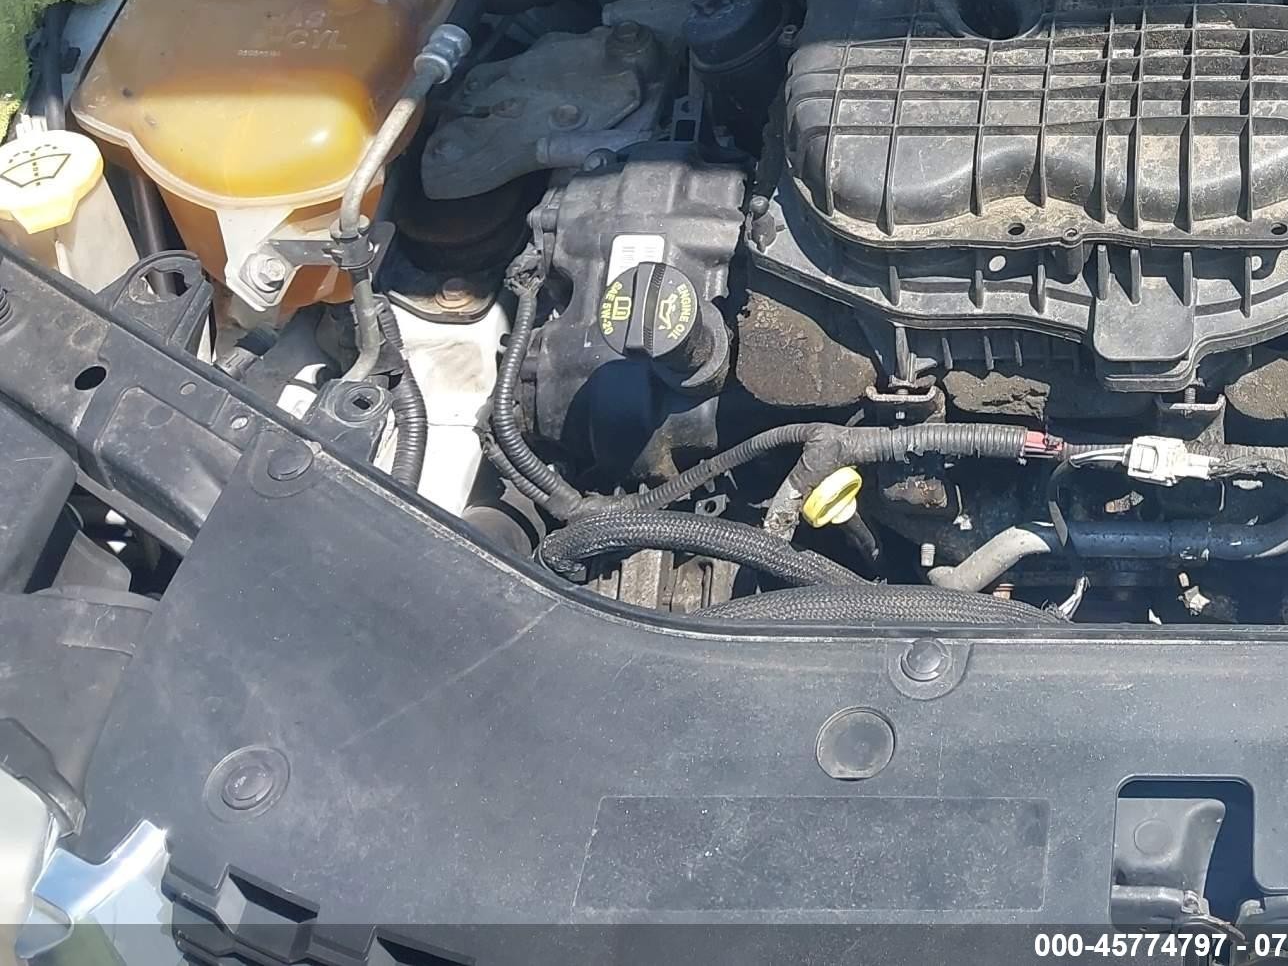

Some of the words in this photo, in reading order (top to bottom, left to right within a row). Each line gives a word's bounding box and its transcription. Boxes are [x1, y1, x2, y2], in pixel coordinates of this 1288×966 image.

[605, 281, 623, 302] SAE
[676, 283, 692, 323] ENGINE
[600, 302, 614, 335] 5W-20
[667, 323, 686, 340] OIL
